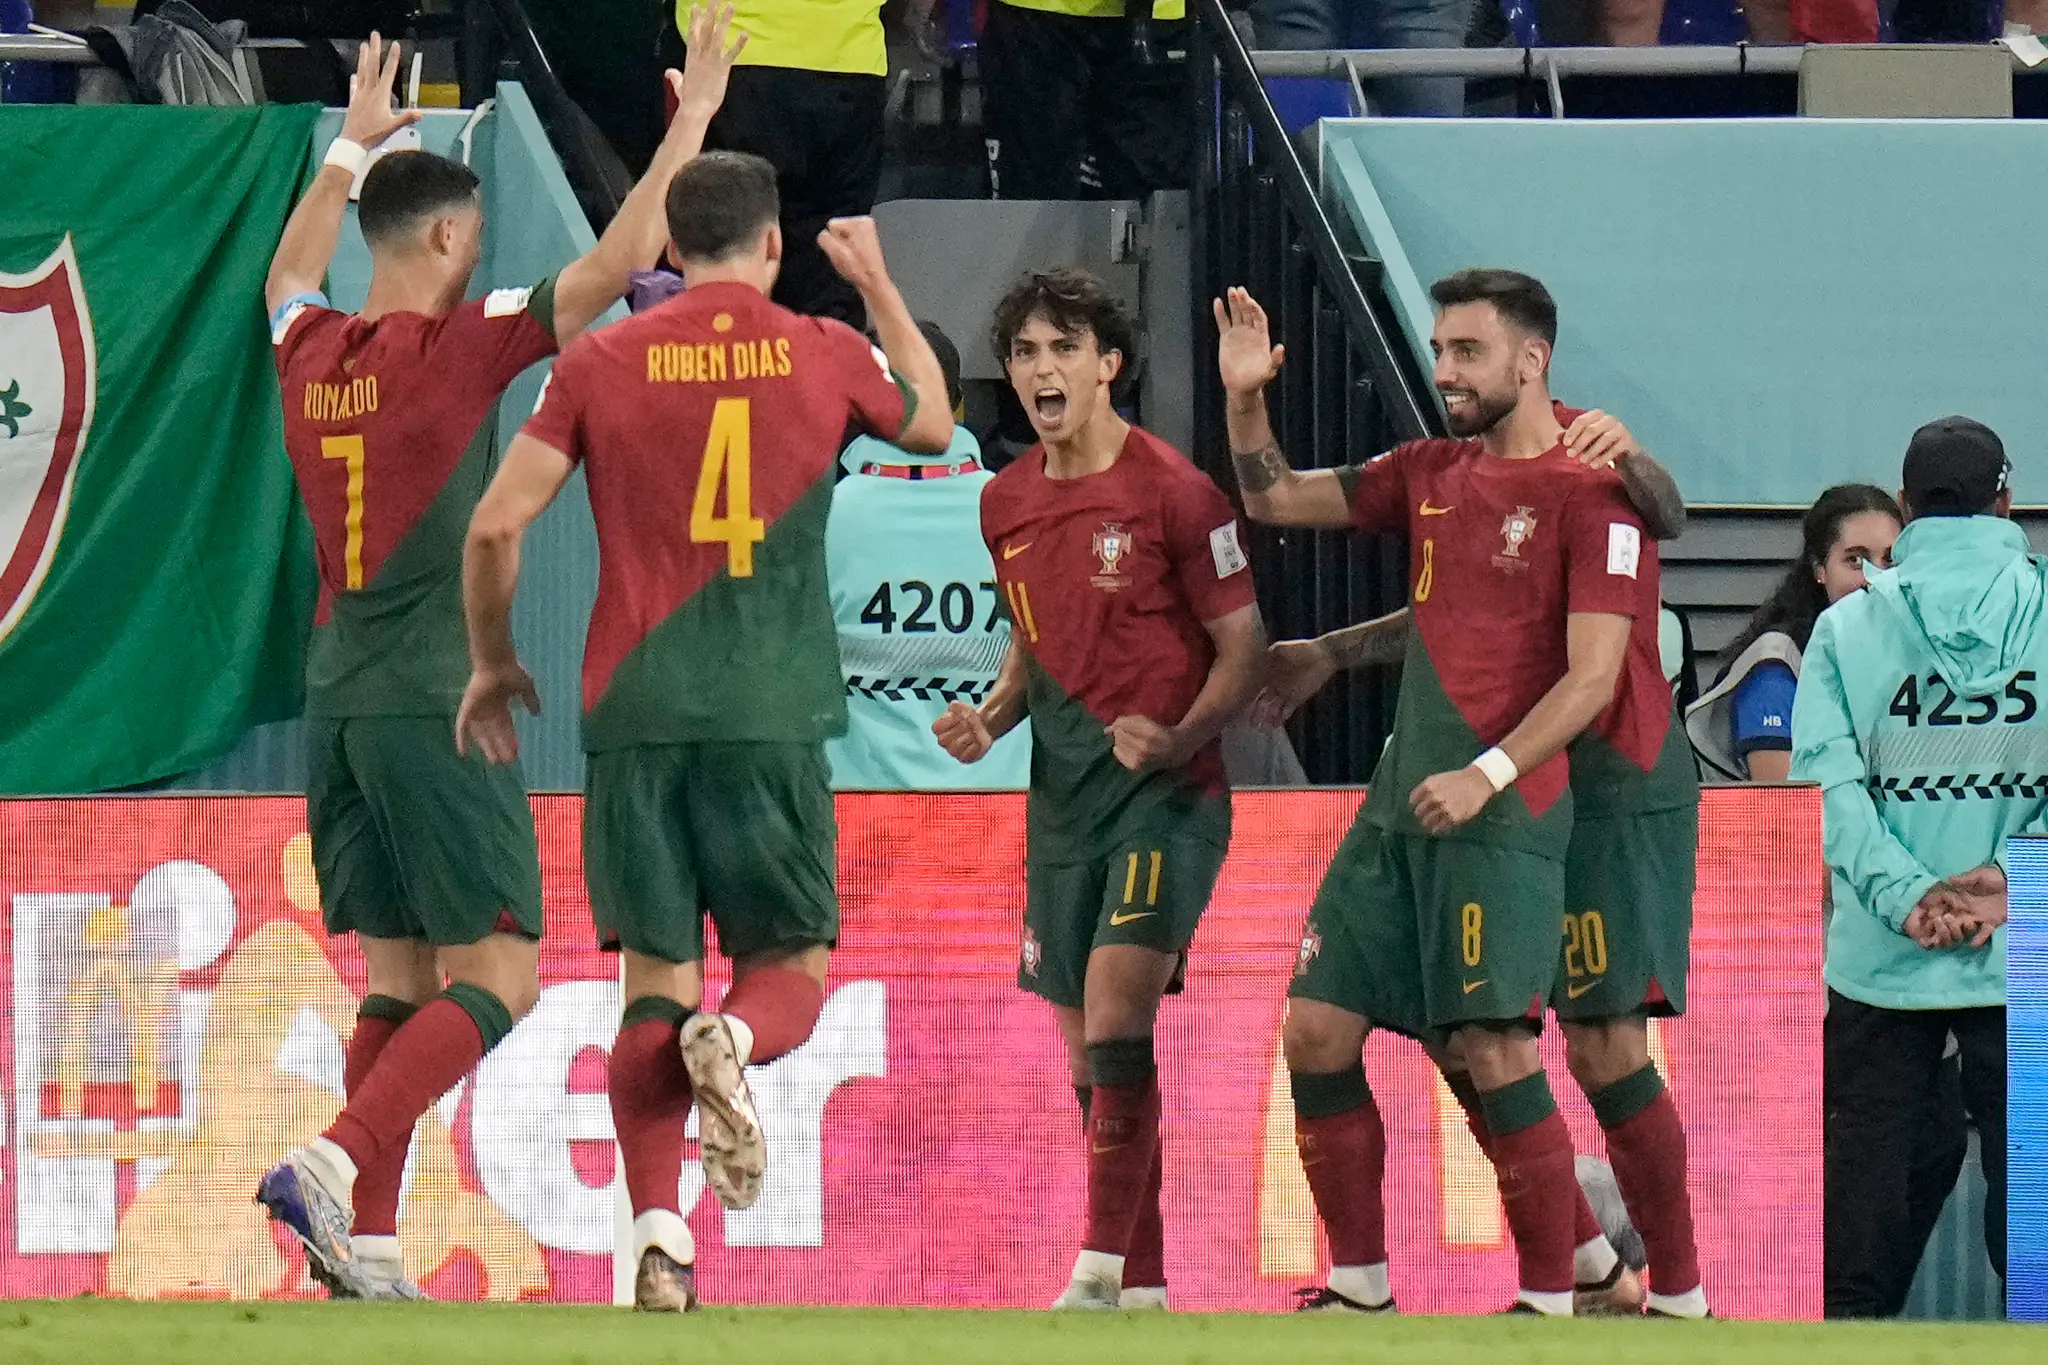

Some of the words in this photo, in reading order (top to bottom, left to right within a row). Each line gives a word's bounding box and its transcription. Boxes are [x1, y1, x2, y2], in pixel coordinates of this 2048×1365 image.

[733, 338, 792, 379] DIAS
[320, 435, 364, 590] 7
[690, 396, 764, 577] 4
[1415, 538, 1433, 602] 8
[861, 580, 999, 634] 4207
[1006, 580, 1039, 643] 11
[1123, 850, 1162, 905] 11
[1462, 902, 1483, 967] 8
[1561, 911, 1608, 977] 20
